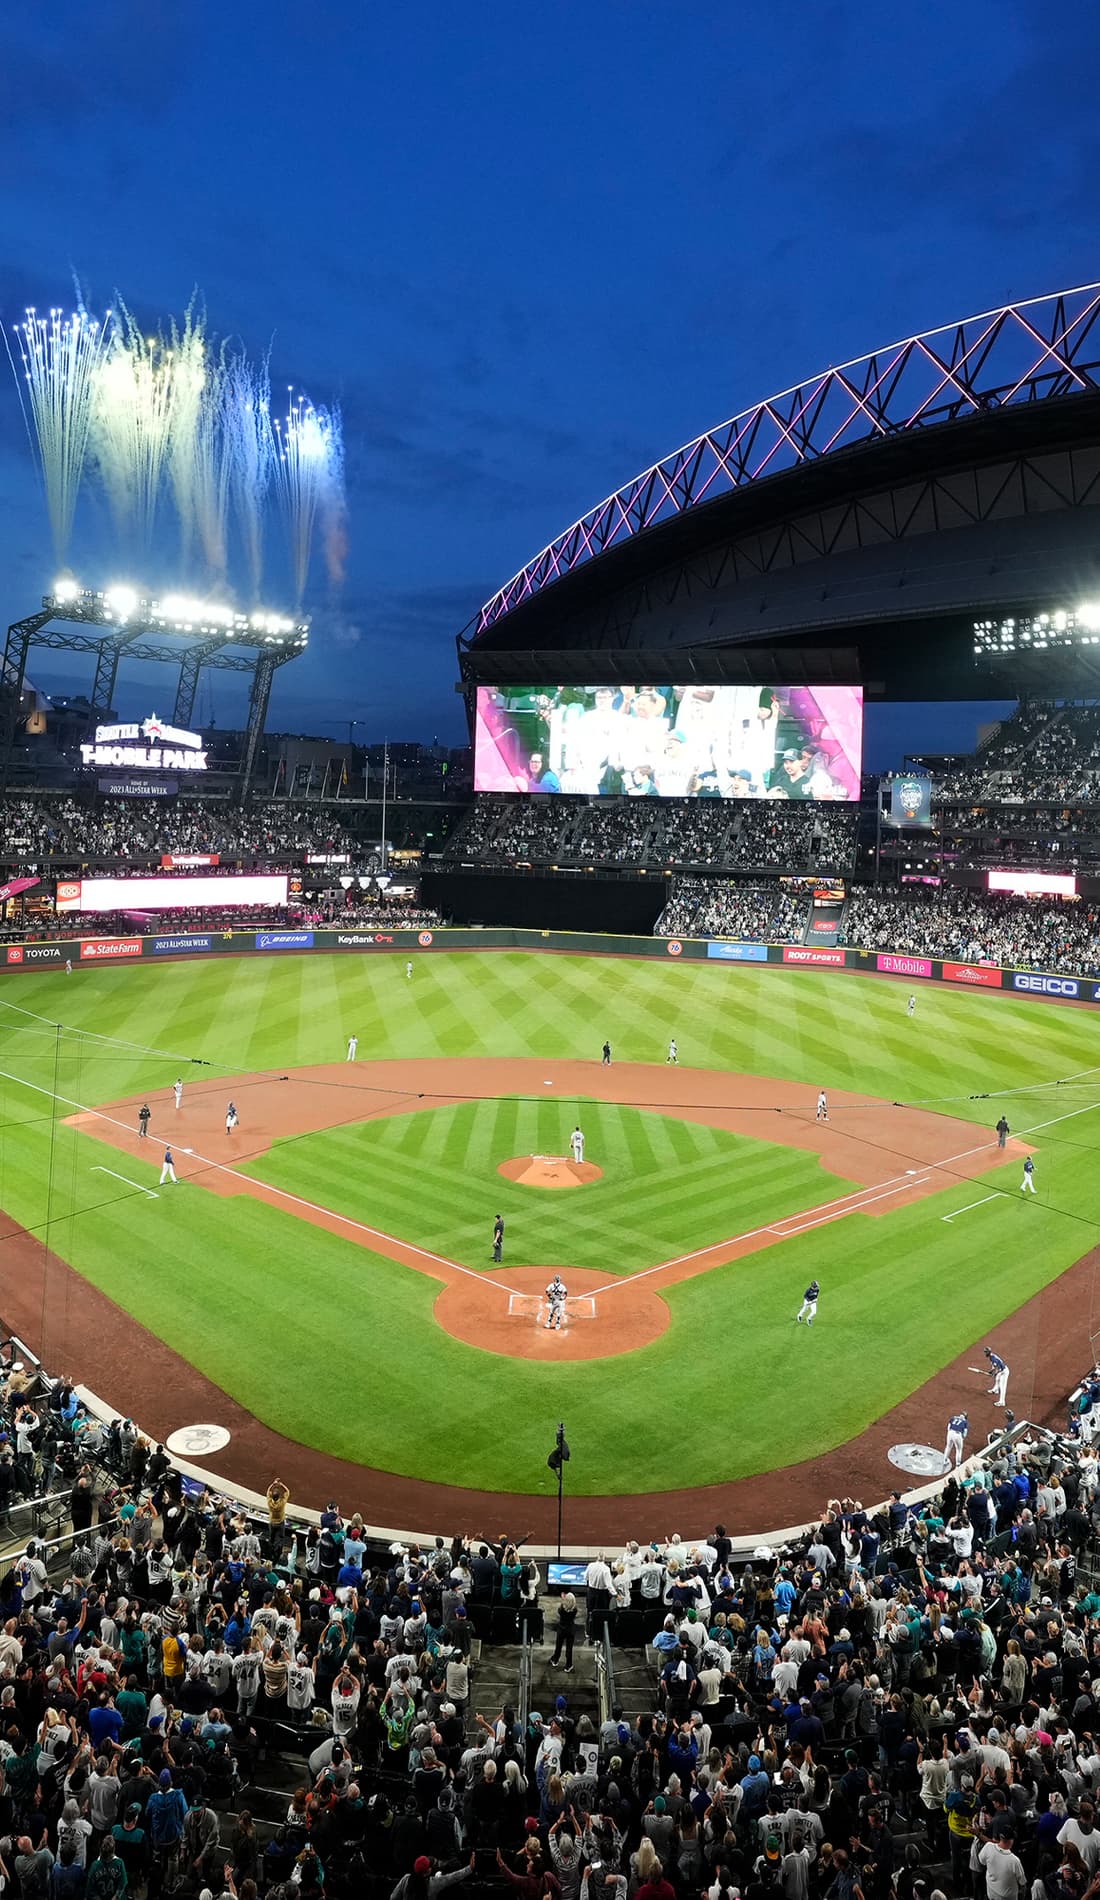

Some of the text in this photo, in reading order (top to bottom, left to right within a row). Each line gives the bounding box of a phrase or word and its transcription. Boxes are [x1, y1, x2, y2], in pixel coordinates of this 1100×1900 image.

[163, 749, 208, 770] PARK
[109, 785, 125, 793] 2023
[150, 786, 168, 795] WEEK
[272, 935, 309, 943] BOEING
[338, 935, 374, 944] KeyBank
[420, 934, 430, 942] 76
[155, 941, 169, 949] 2023
[193, 938, 209, 947] WEEK
[671, 944, 680, 952] 76
[25, 948, 60, 958] TOYOTA
[788, 952, 811, 961] ROOT
[1015, 975, 1078, 996] GEICO
[150, 1561, 160, 1573] 18
[240, 1667, 254, 1680] 44
